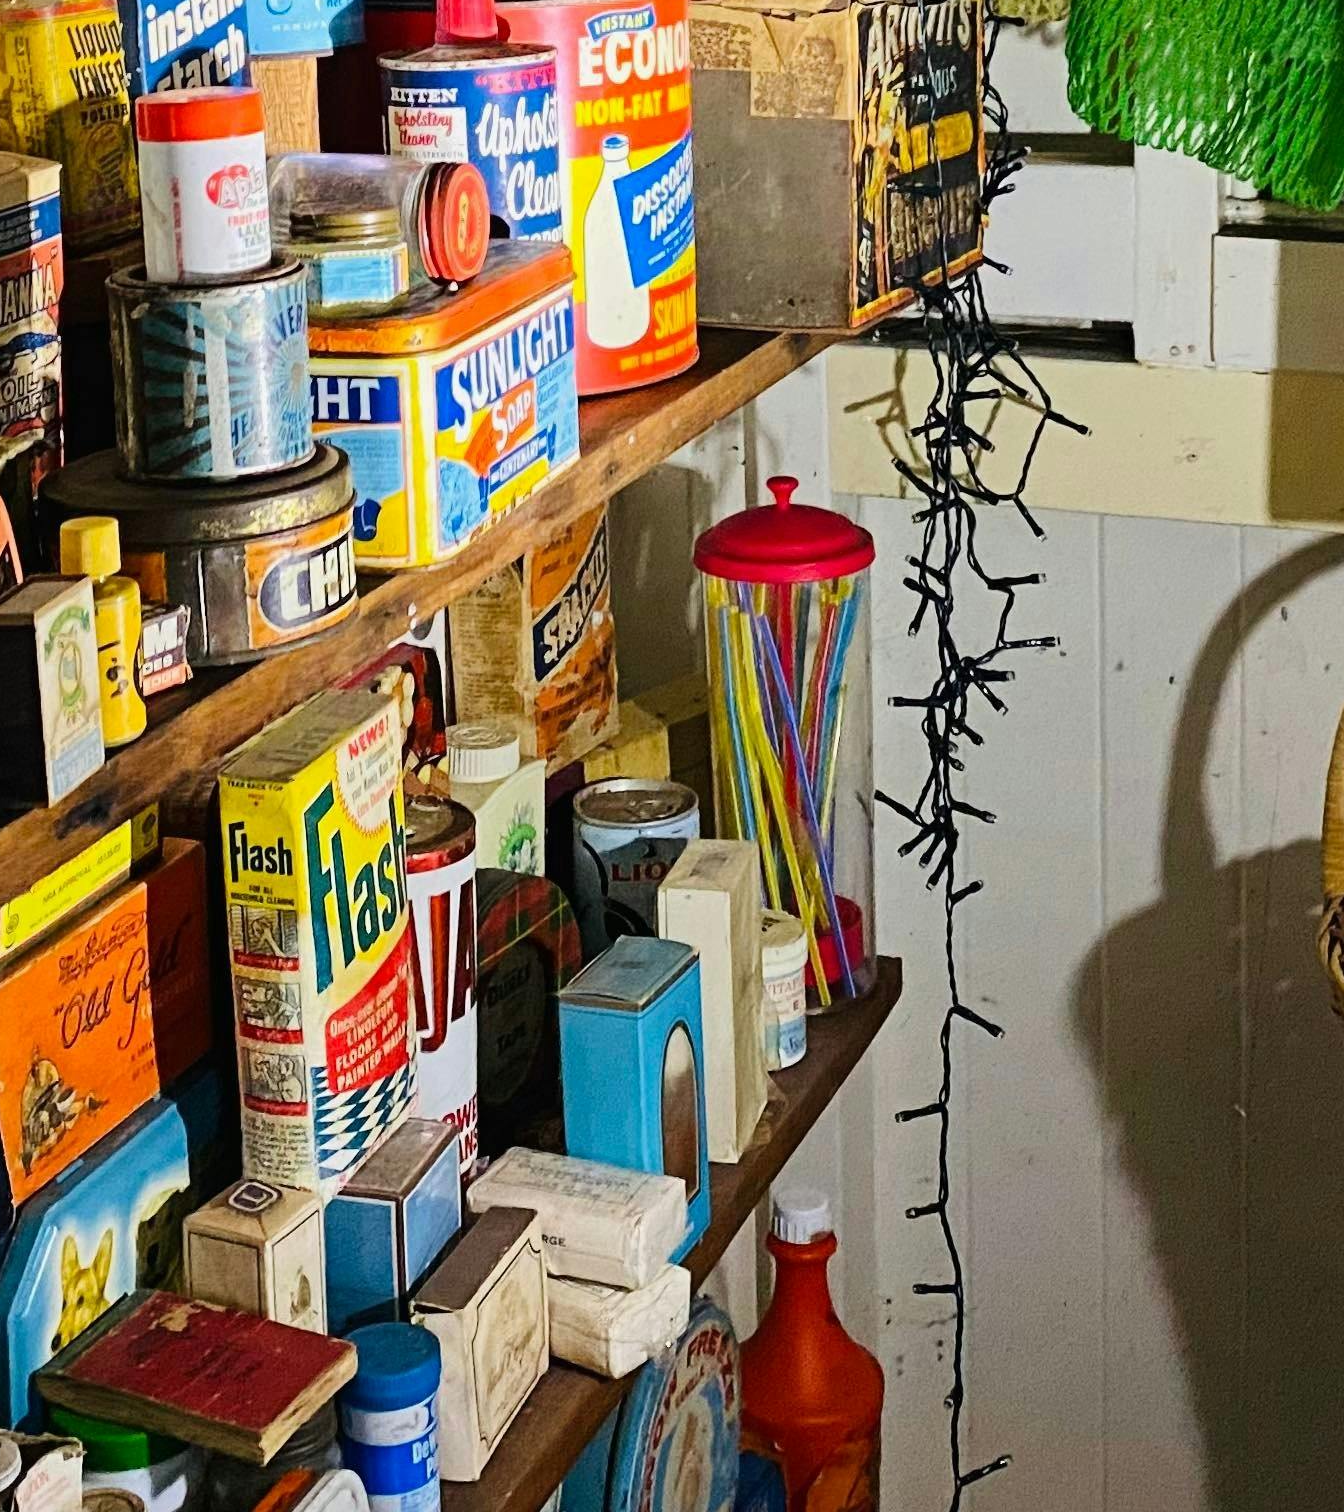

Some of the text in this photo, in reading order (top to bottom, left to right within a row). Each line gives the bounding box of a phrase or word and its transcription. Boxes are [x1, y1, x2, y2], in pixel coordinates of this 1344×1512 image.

[594, 10, 651, 33] INSTANT
[389, 87, 459, 105] KITTEN
[576, 93, 662, 128] NON-FAT
[1, 370, 40, 402] OIL
[450, 297, 571, 442] SUNLIGHT
[492, 389, 532, 452] SOAP
[228, 821, 294, 884] Flash
[304, 780, 407, 996] Flash
[336, 1031, 378, 1074] FLOORS
[337, 1051, 381, 1092] PAINTED
